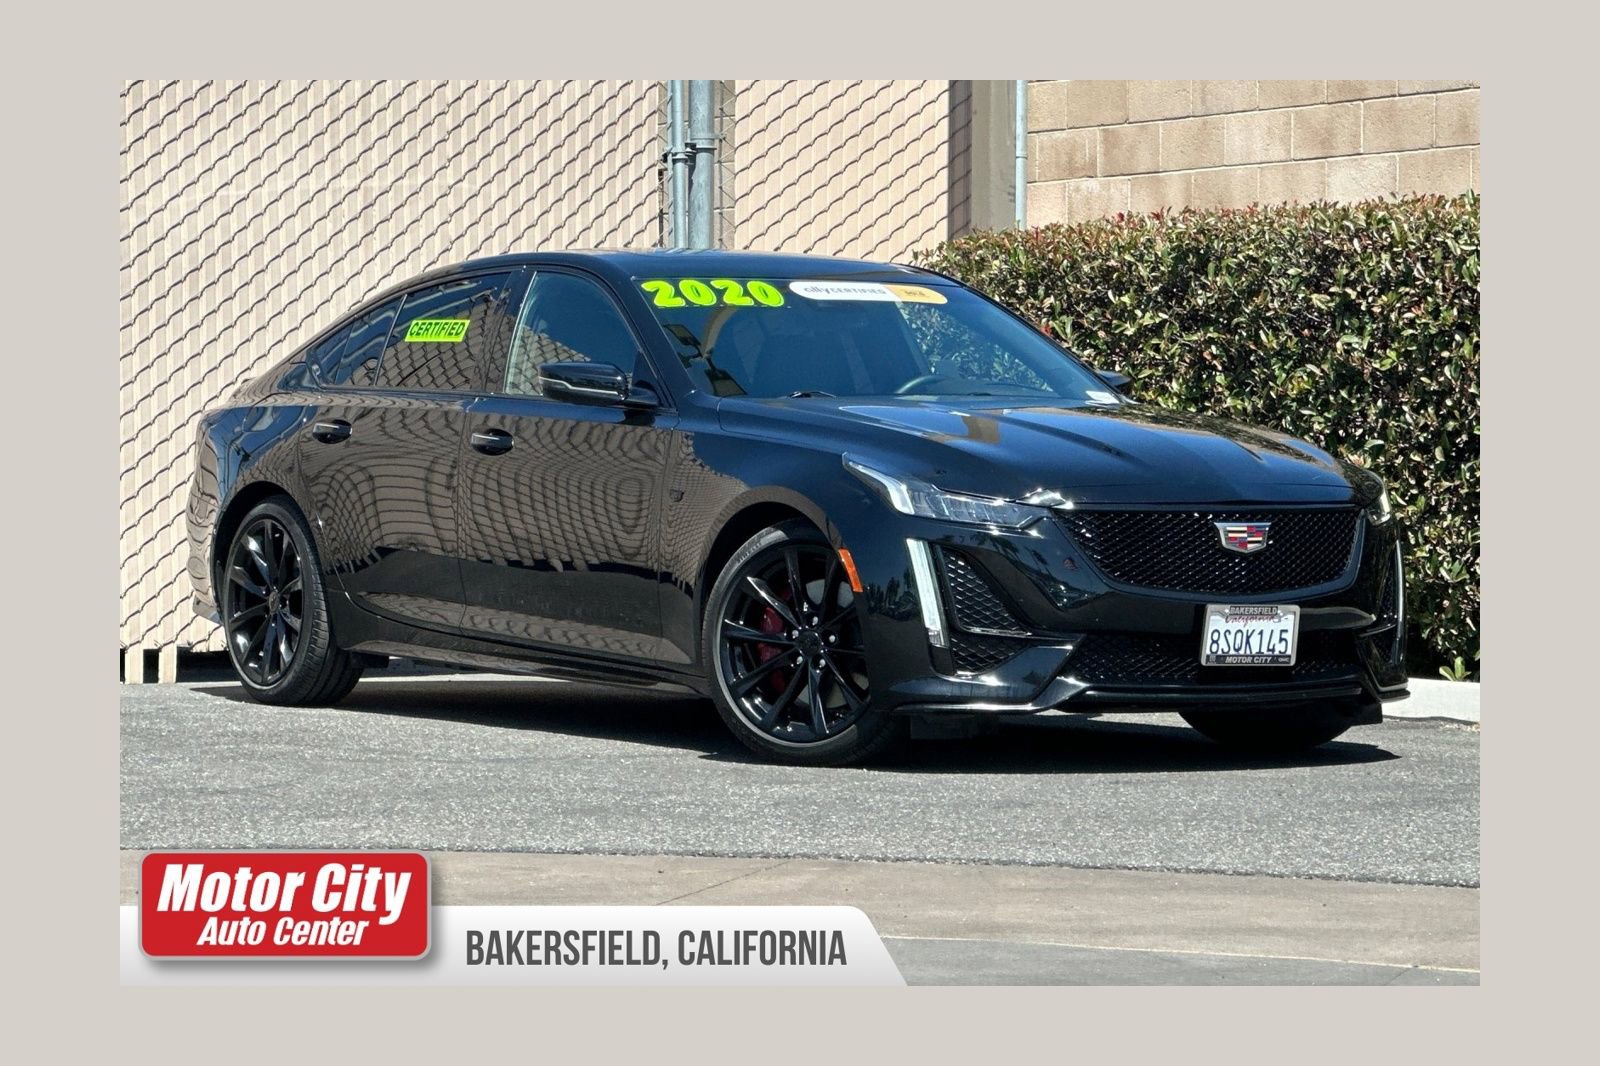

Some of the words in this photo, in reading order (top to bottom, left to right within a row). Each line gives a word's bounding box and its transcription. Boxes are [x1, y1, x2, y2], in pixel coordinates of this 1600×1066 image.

[641, 279, 785, 307] 2020
[409, 321, 466, 337] CERTIFIED
[1230, 607, 1277, 615] BAKERSFIELD
[1209, 629, 1289, 655] 8SQK145
[1225, 656, 1253, 664] MOTOR
[1253, 656, 1272, 664] CITY
